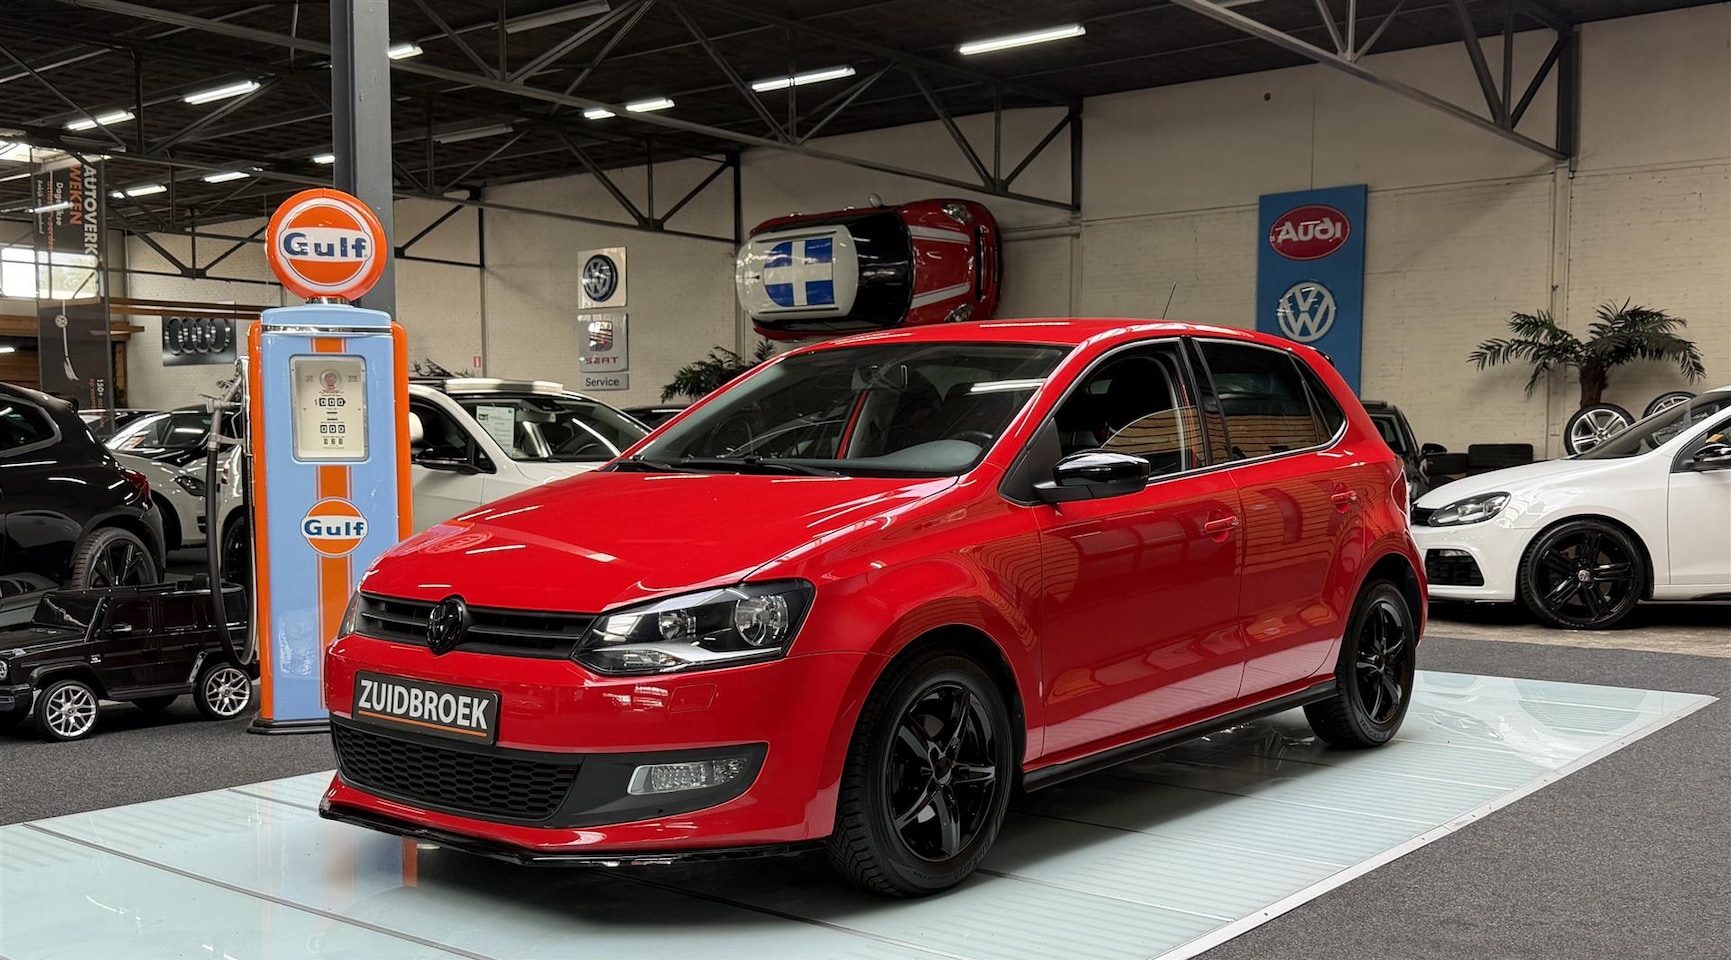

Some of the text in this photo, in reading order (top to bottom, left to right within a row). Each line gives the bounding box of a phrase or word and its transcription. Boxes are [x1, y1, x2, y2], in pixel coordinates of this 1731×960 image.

[69, 164, 82, 225] WEKEN
[283, 232, 367, 258] Gulf
[585, 356, 619, 365] SEAT
[586, 377, 620, 387] Service
[304, 519, 364, 536] Gulf
[358, 679, 490, 730] ZUIDBROEK
